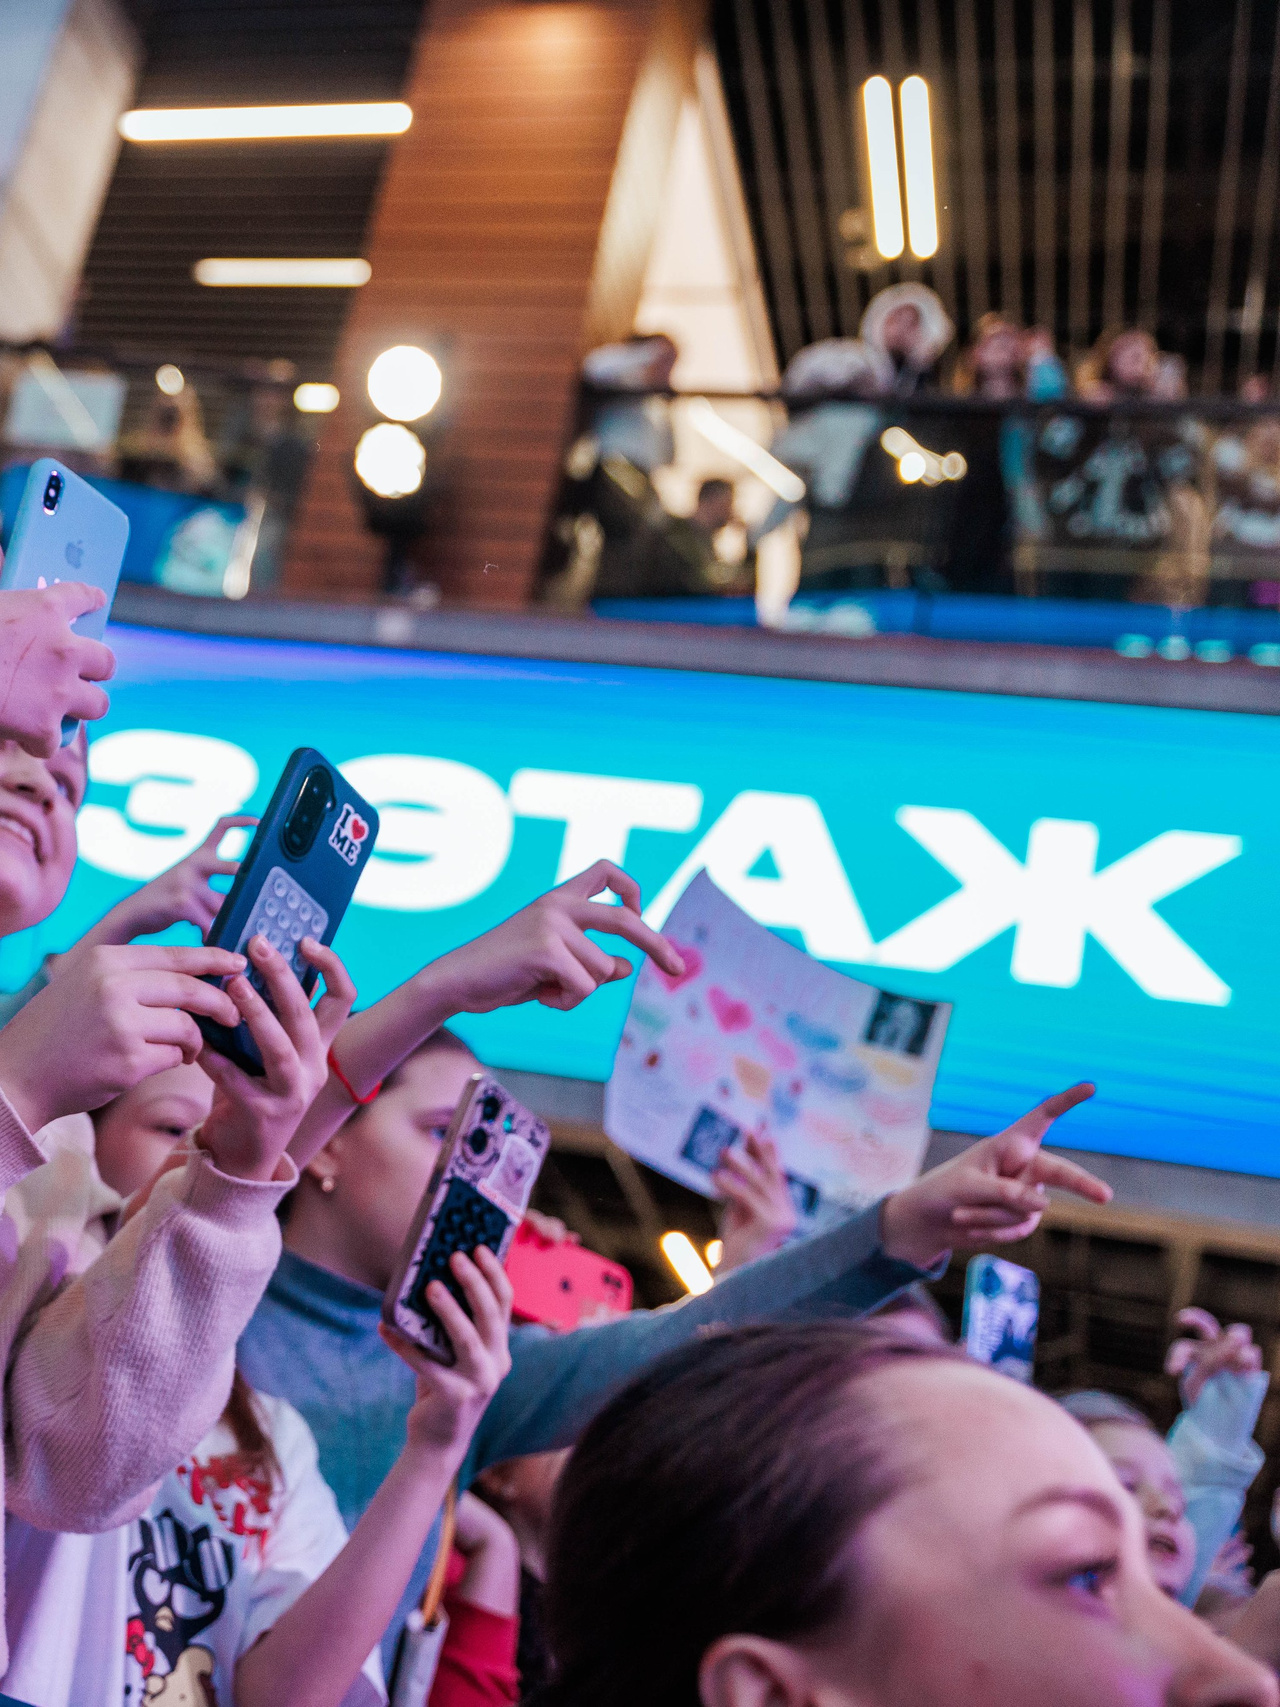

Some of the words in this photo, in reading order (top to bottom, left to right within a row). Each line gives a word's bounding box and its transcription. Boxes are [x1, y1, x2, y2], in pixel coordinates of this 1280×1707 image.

[77, 728, 260, 882] 3
[328, 752, 1244, 1008] ЭТАЖ
[330, 828, 360, 863] ME
